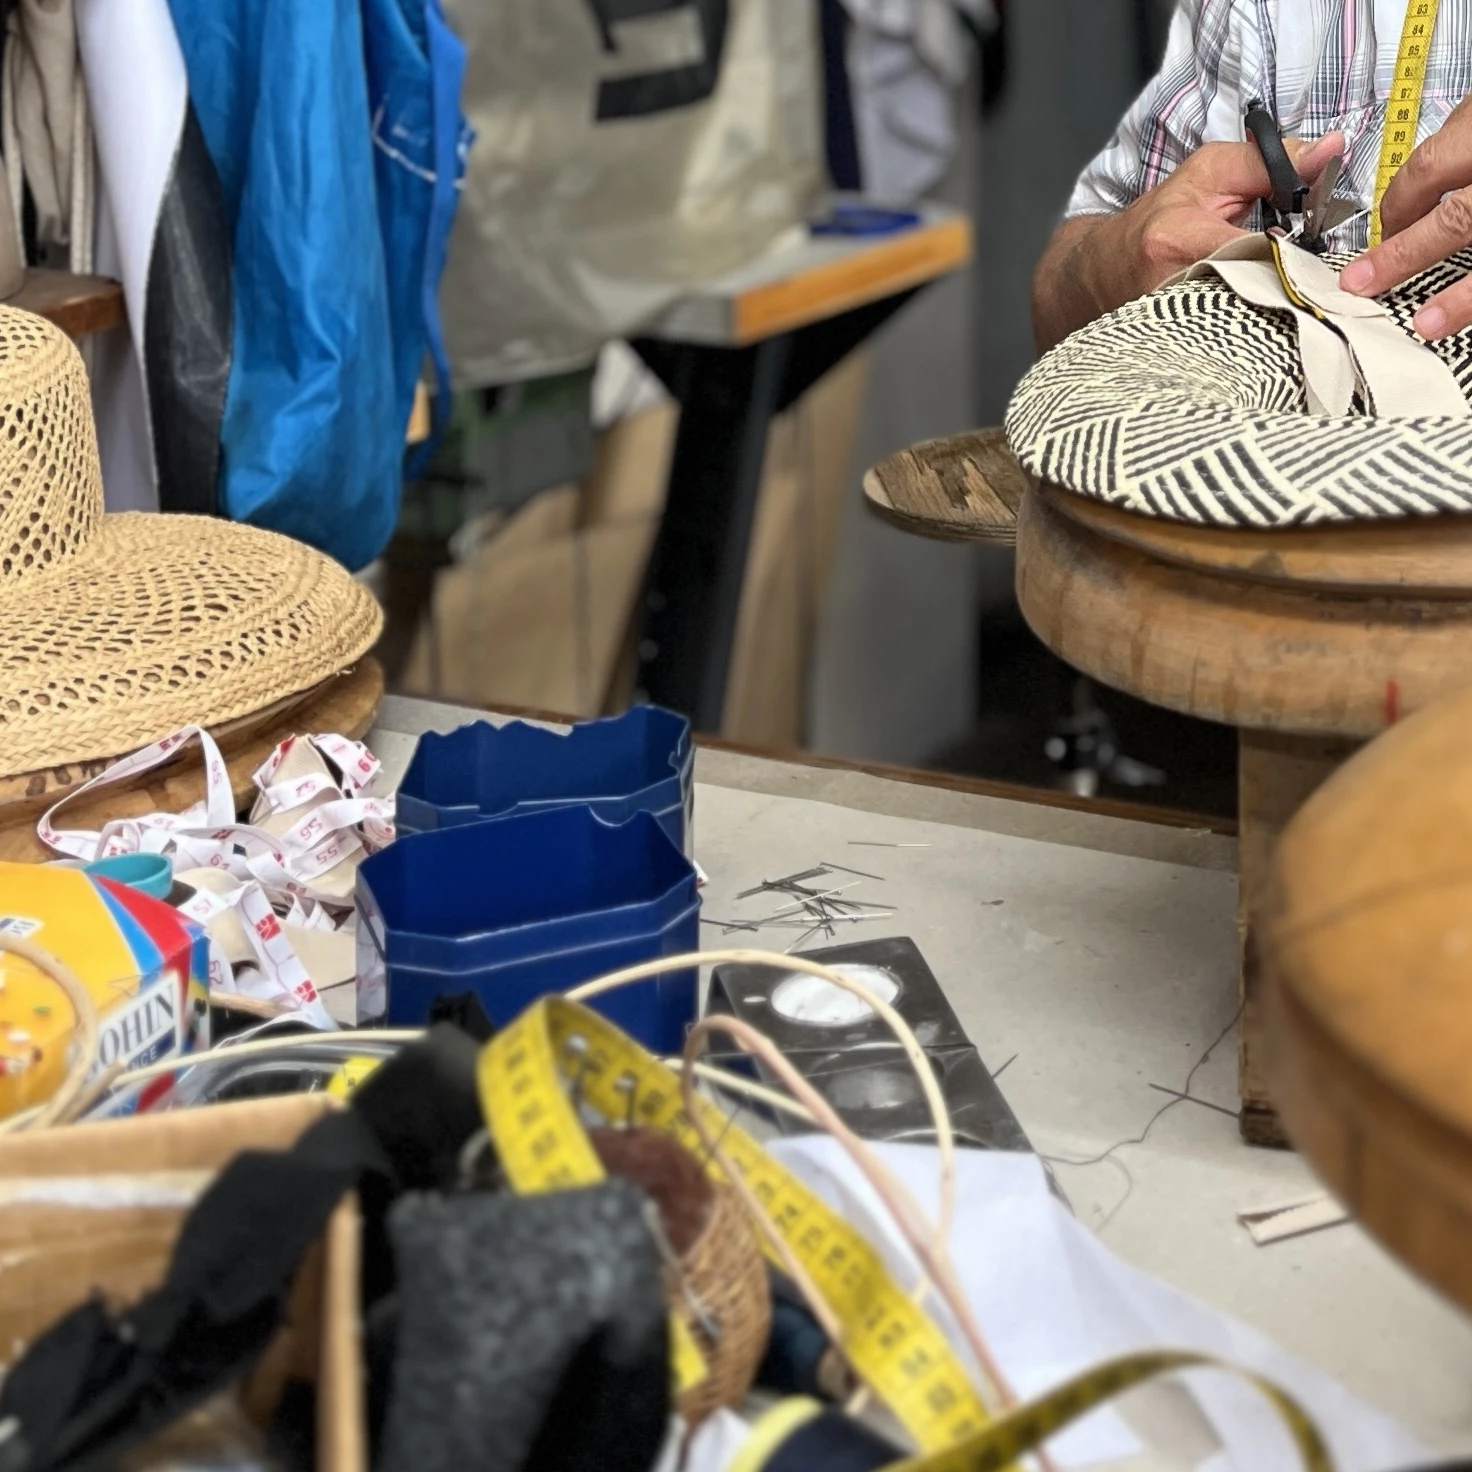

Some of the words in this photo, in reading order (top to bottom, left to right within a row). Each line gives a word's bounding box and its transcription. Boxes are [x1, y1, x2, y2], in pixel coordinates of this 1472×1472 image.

[1411, 23, 1424, 36] 84
[316, 845, 338, 865] 55
[86, 982, 174, 1082] OHIN
